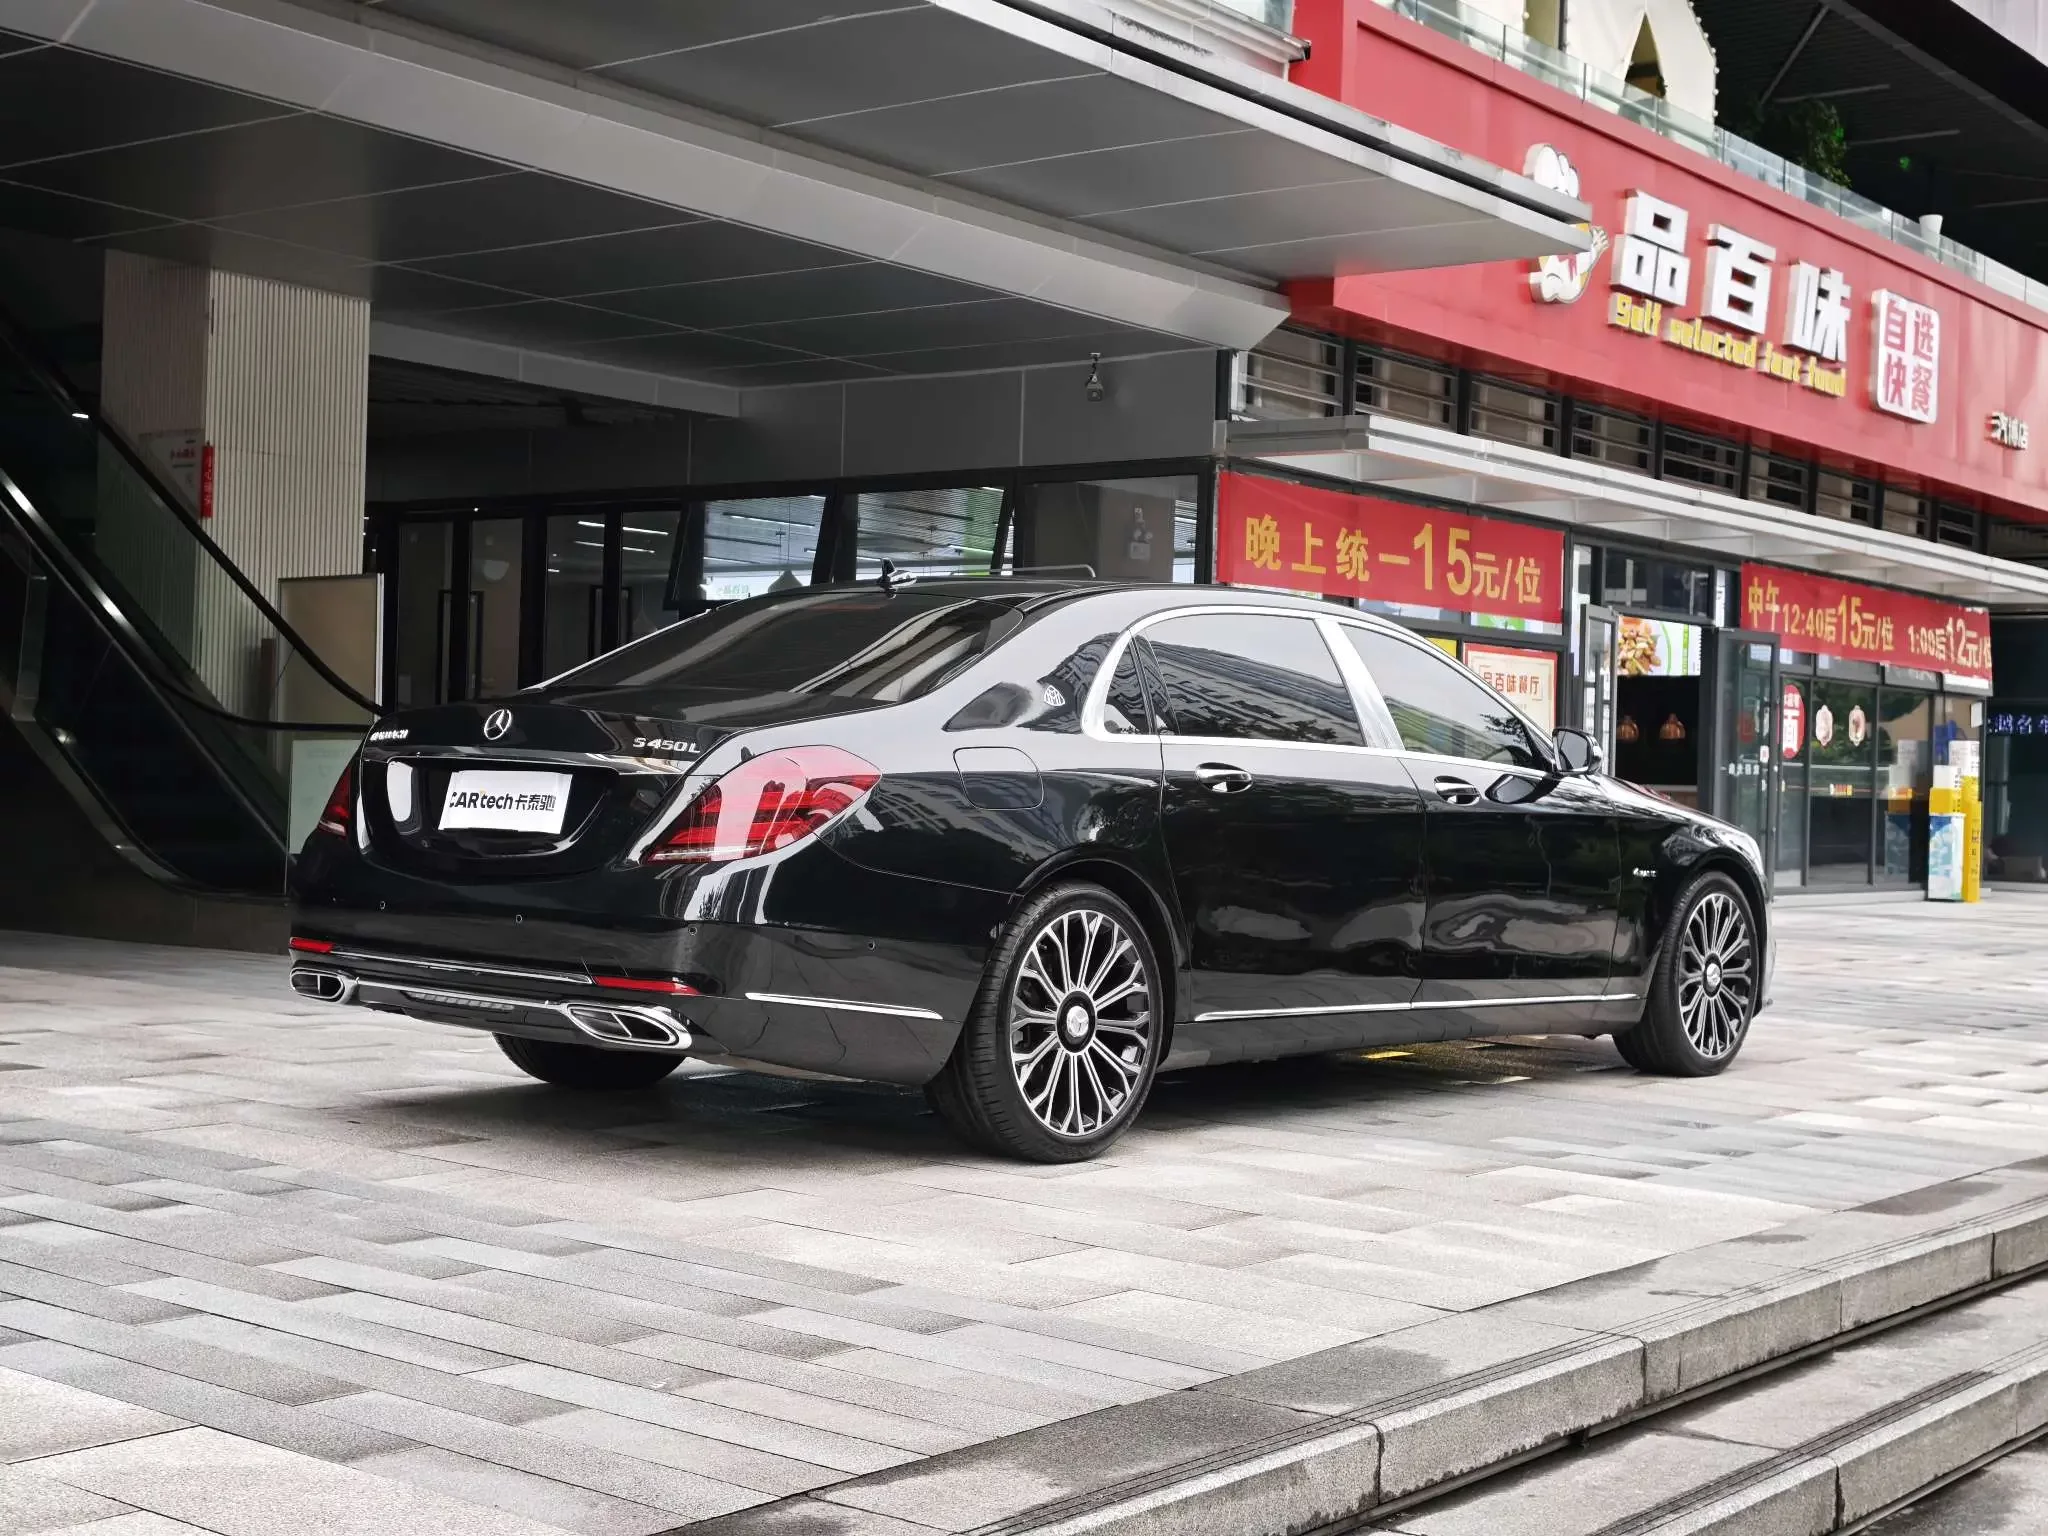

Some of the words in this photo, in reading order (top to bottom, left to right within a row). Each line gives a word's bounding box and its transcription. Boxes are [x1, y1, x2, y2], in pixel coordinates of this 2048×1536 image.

[1611, 188, 1852, 362] 品百味
[1884, 299, 1934, 362] 自选
[1883, 352, 1933, 416] 快餐
[1245, 513, 1542, 604] 晚上统一15元/位
